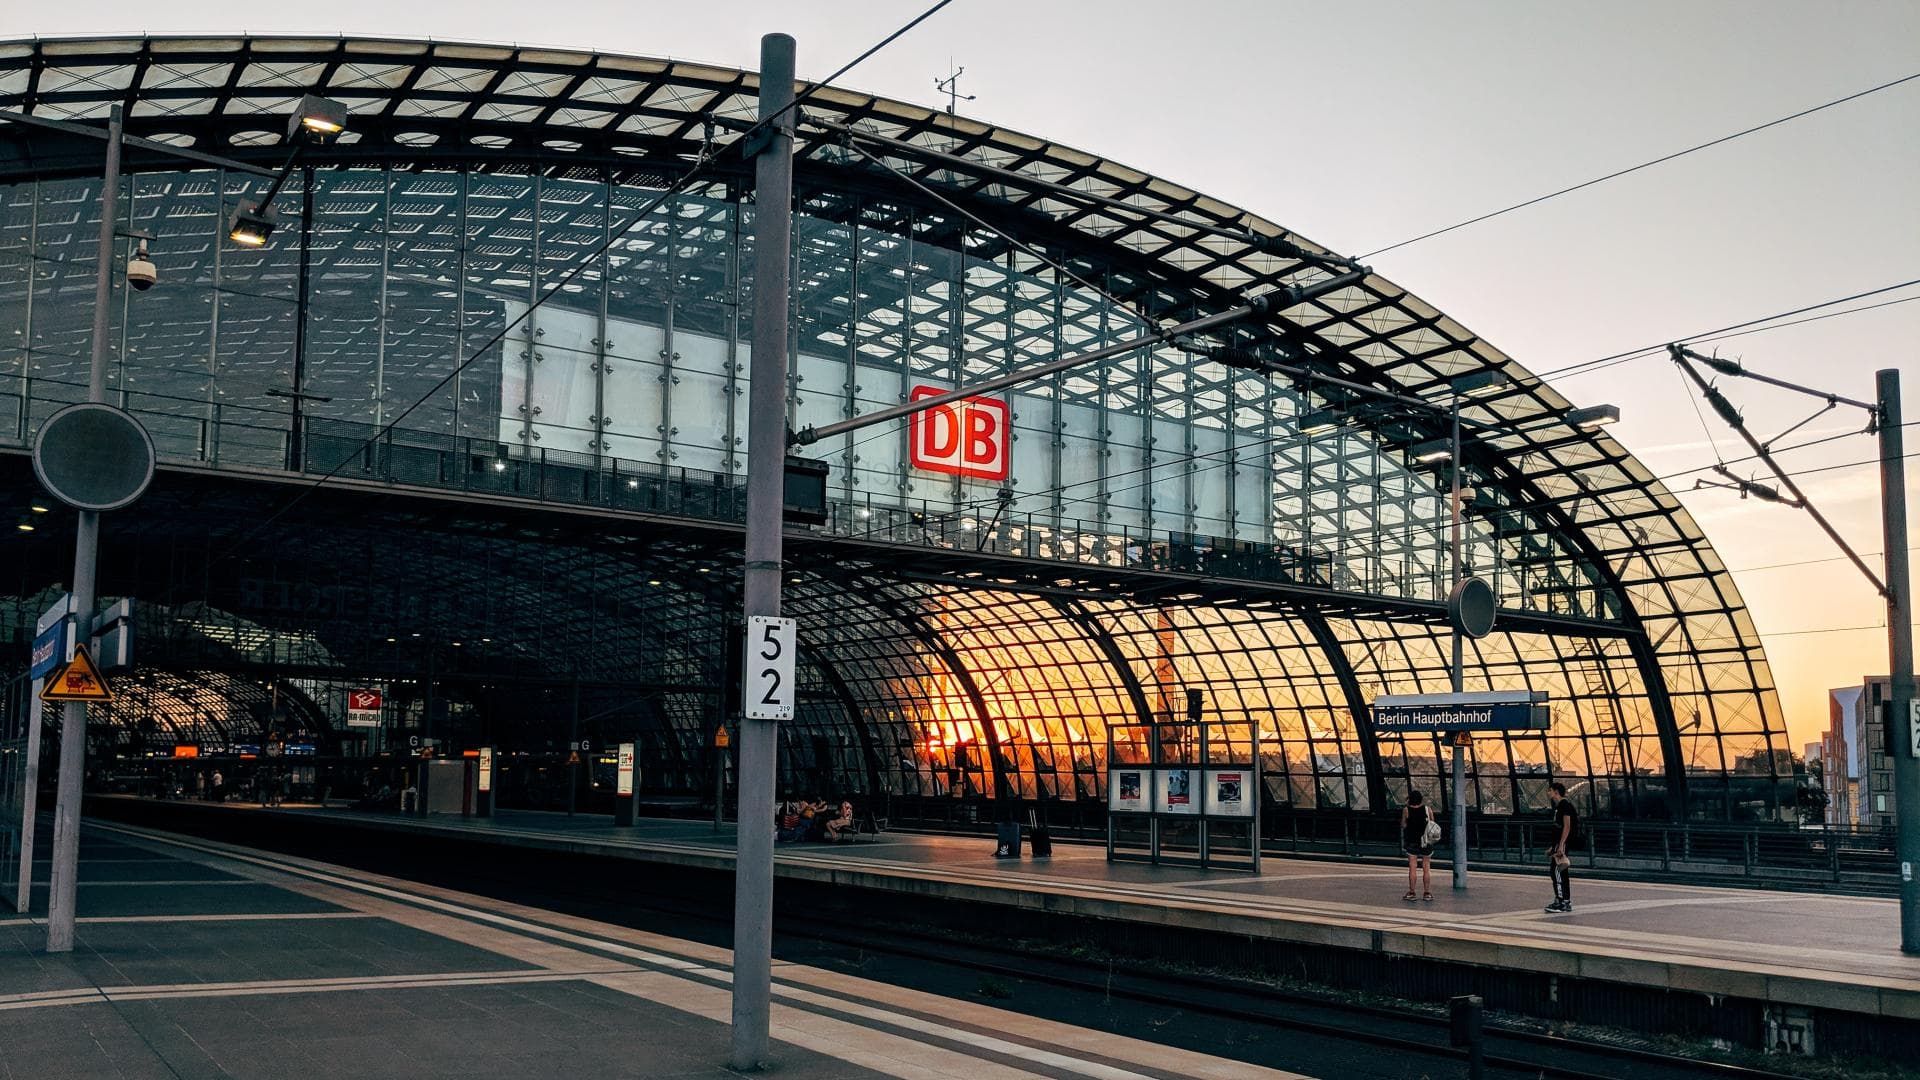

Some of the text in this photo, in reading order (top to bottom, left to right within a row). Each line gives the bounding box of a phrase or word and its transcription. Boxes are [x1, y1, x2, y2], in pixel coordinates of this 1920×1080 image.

[924, 402, 997, 465] DB
[760, 624, 782, 661] 5
[760, 668, 781, 705] 2
[1378, 709, 1493, 726] Berlin Hauptbahnhof
[409, 735, 419, 747] G
[581, 740, 590, 751] G
